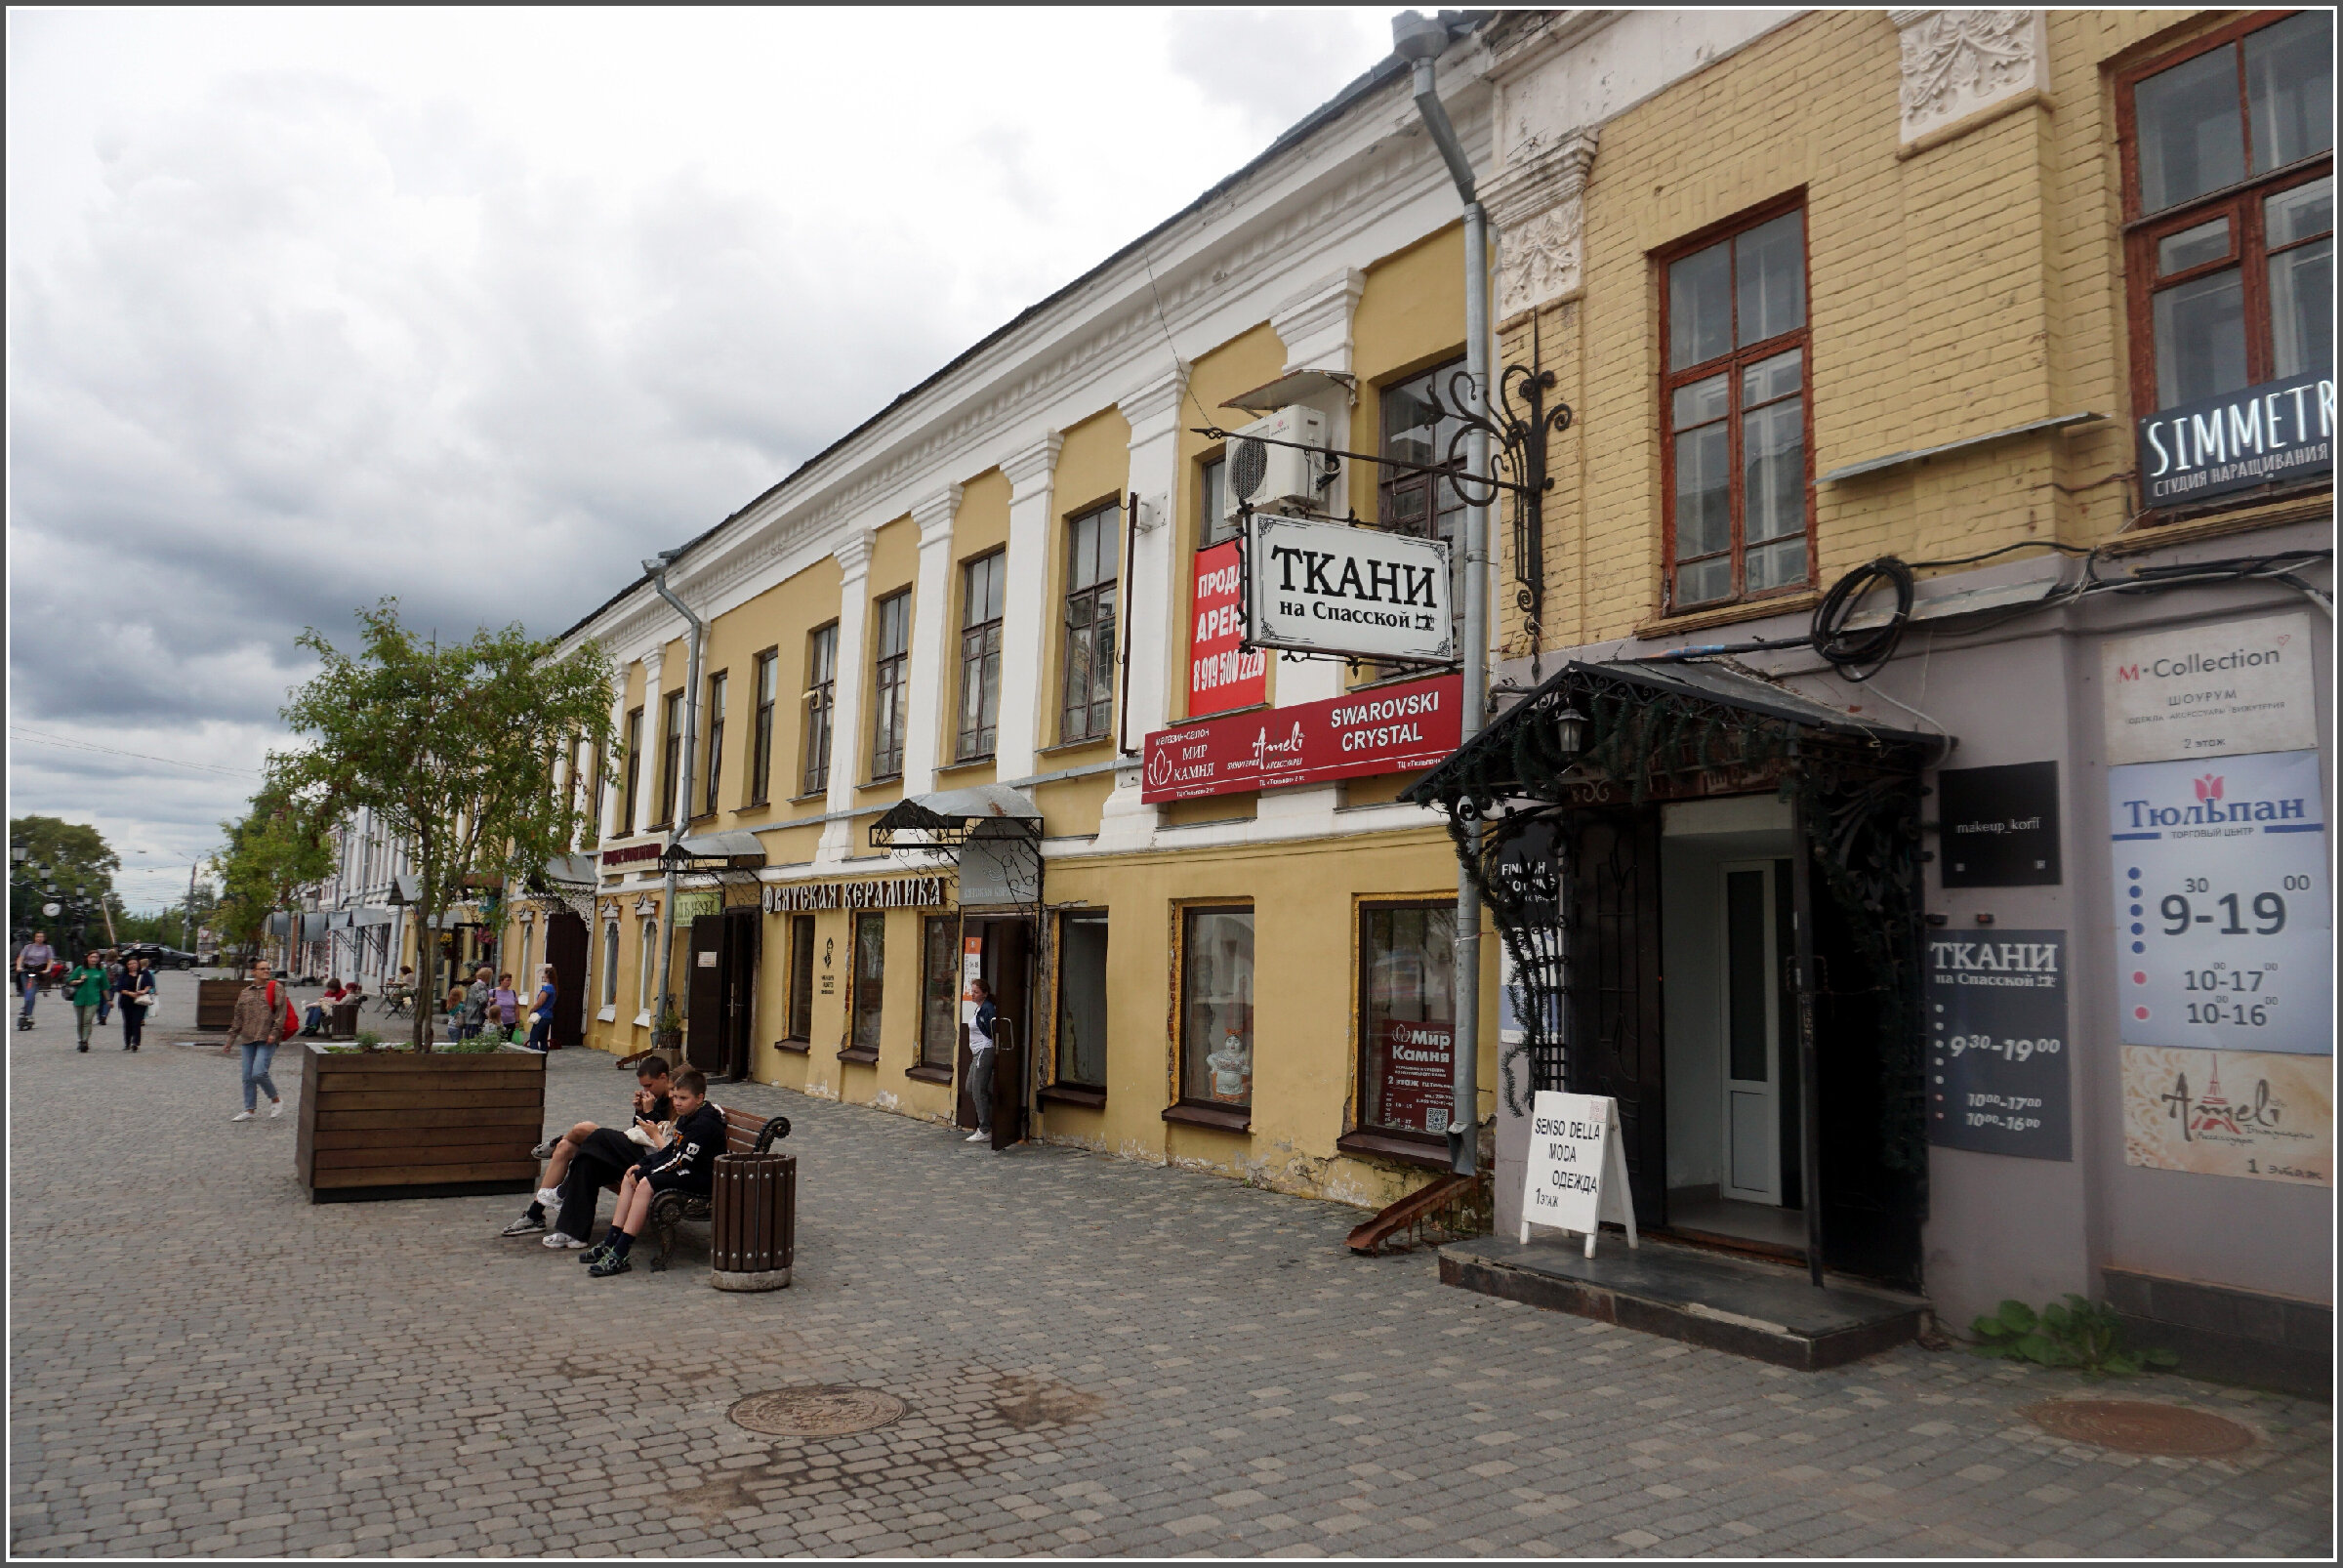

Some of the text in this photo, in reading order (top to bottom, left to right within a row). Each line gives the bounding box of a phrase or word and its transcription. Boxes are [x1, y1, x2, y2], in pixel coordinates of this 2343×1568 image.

[2148, 380, 2334, 477] SIMMETR
[2154, 442, 2328, 497] СТУДИЯ НАРАЩИВАНИЯ
[1270, 545, 1438, 608] ТКАНИ
[1279, 600, 1411, 629] на Спасской
[1193, 659, 1201, 692] 8
[1219, 648, 1239, 686] 500
[1331, 691, 1440, 728] SWAROVSKI
[2167, 689, 2238, 707] ШОУРУМ
[1253, 721, 1305, 770] Ameli
[1341, 722, 1423, 753] CRYSTAL
[2183, 737, 2192, 750] 2
[1182, 744, 1208, 761] МИР
[1172, 763, 1215, 781] КАМНЯ
[2123, 797, 2306, 828] Тюльпан
[2170, 826, 2254, 840] ТОРГОВЫЙ ЦЕНТР
[774, 877, 943, 912] ВЯТСКАЯ КЕРАМИКА
[1929, 941, 2059, 972] ТКАНИ
[1935, 972, 2035, 988] на Спасской
[1412, 1030, 1452, 1050] Мир
[1392, 1045, 1450, 1063] Камня
[1387, 1075, 1394, 1085] 2
[2161, 1071, 2280, 1142] Ameli
[1535, 1117, 1601, 1140] SENSO DELLA
[1548, 1142, 1577, 1163] MODA
[2247, 1158, 2260, 1175] 1
[1552, 1170, 1598, 1195] ОДЕЖДА
